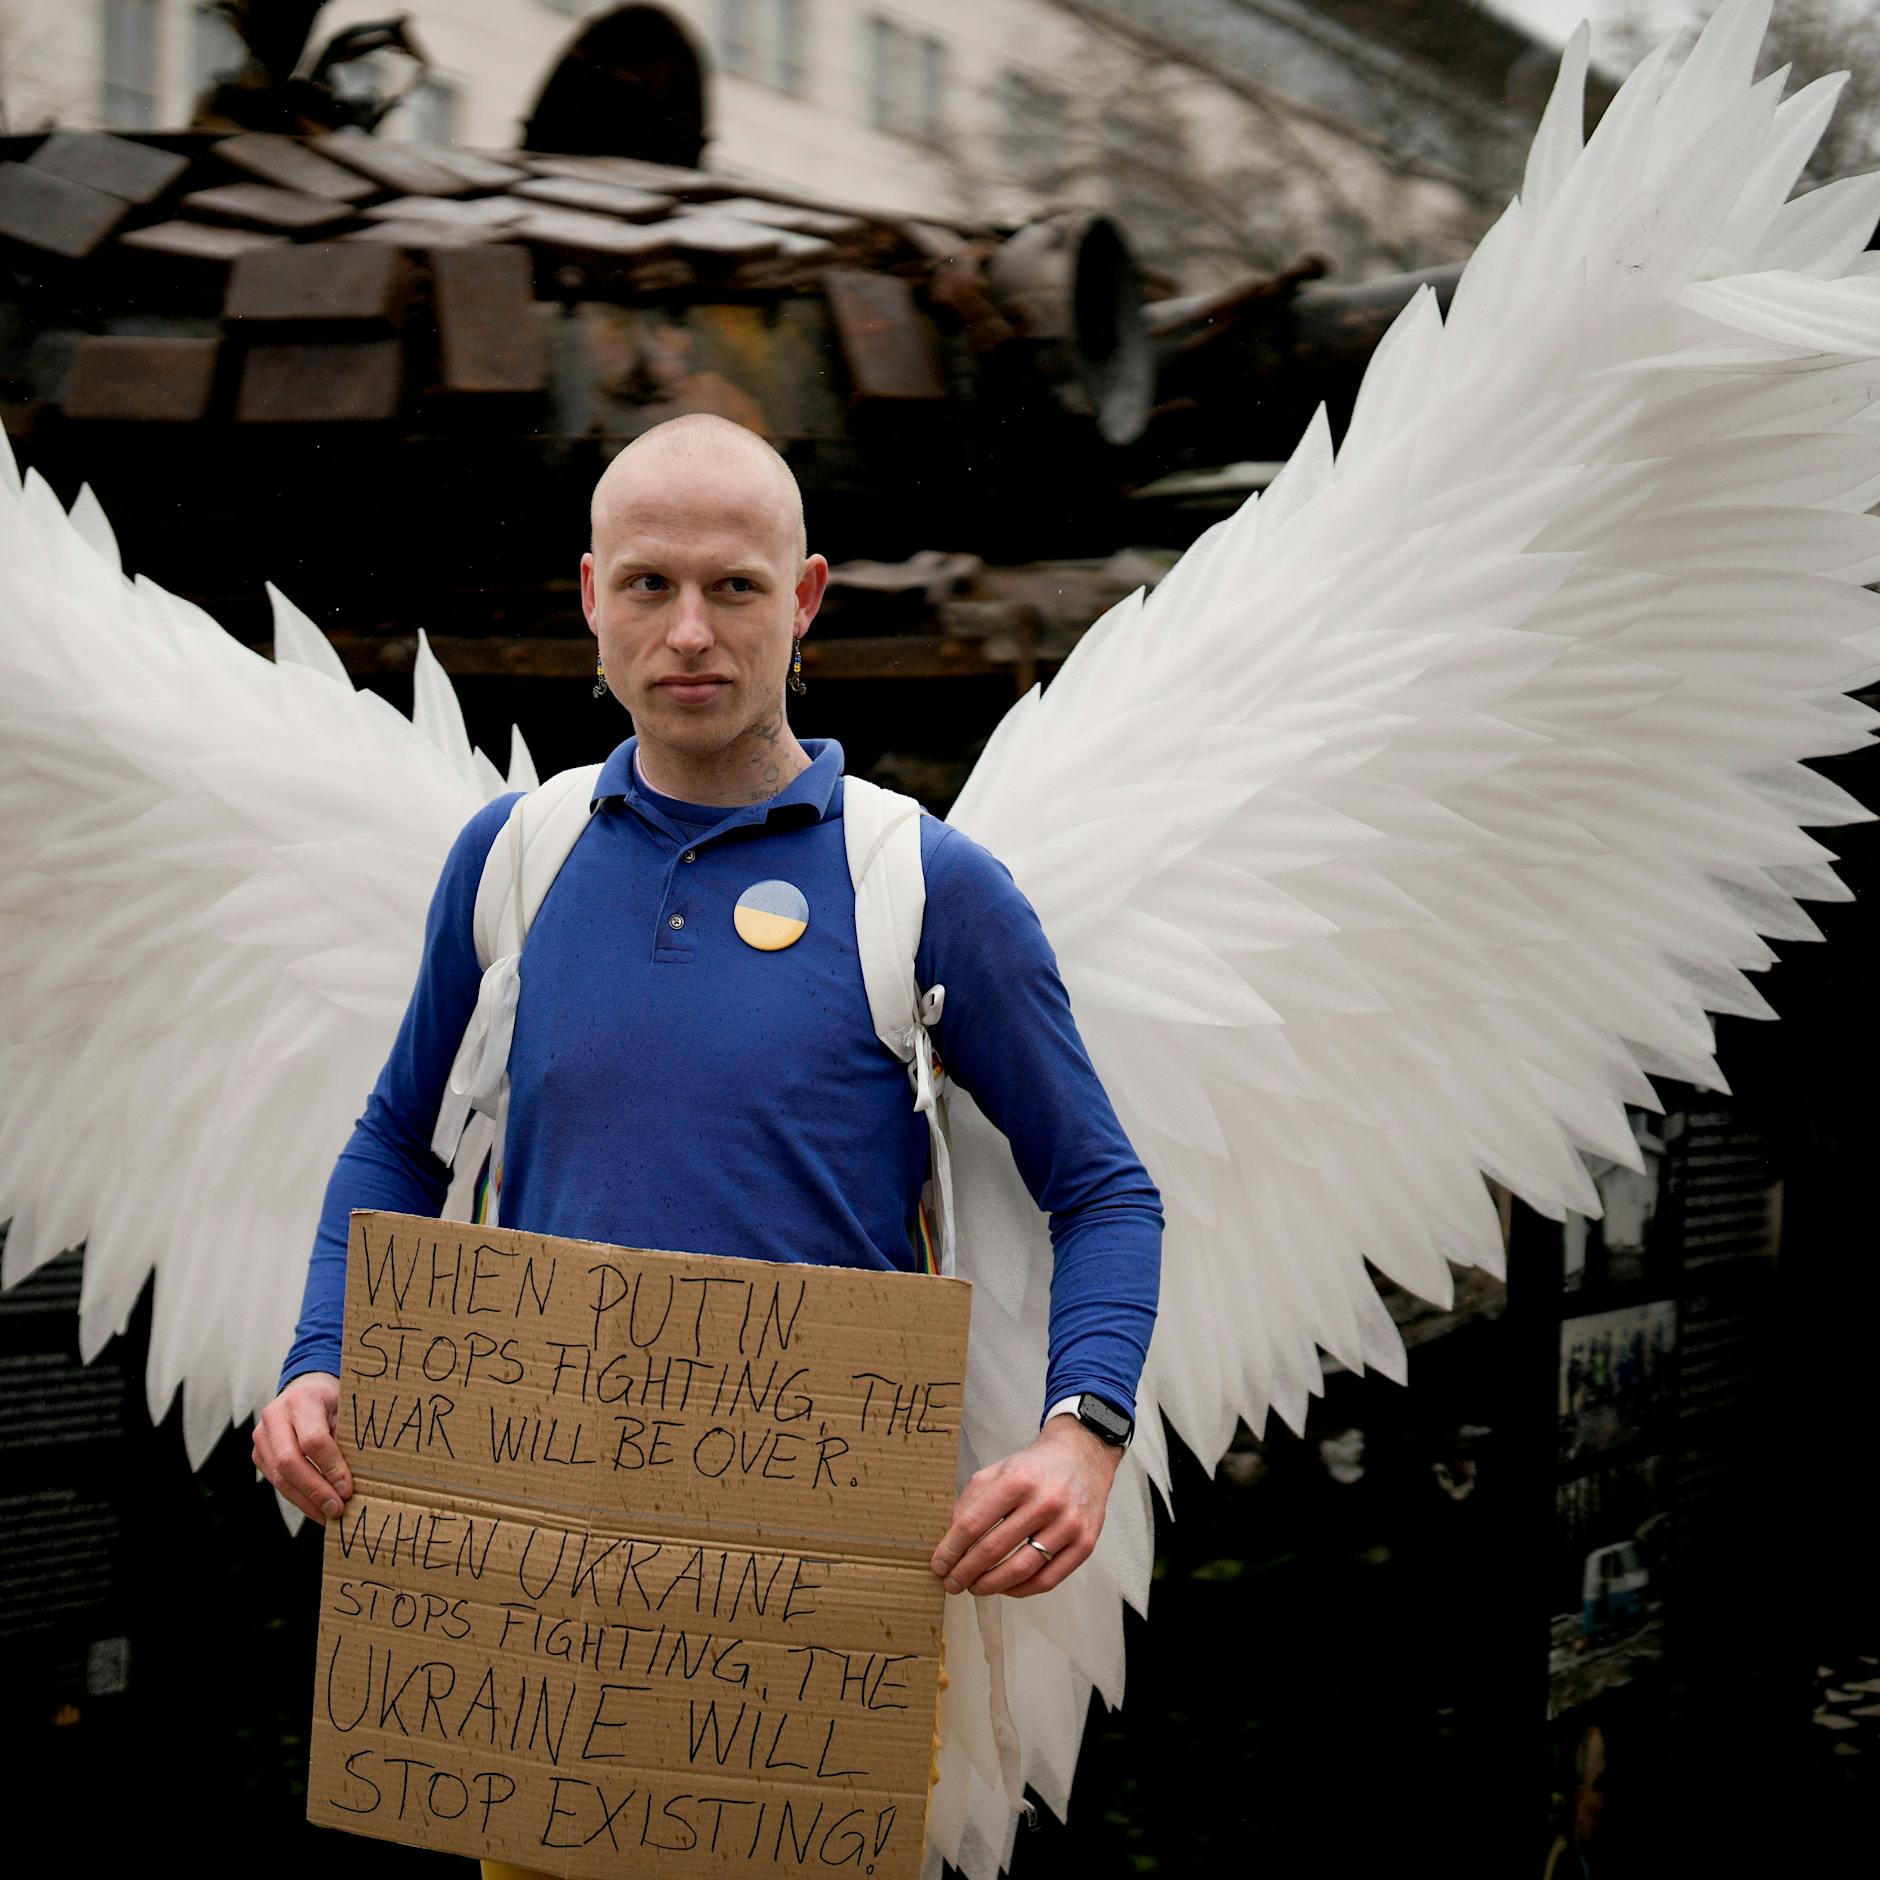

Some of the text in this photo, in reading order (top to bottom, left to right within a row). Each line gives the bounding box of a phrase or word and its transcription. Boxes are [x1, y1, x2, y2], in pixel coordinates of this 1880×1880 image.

[363, 1227, 805, 1358] WHEN PUTIN
[350, 1323, 961, 1435] STOPS FIGHTING, THE
[351, 1393, 858, 1489] WAR WILL BE OVER.
[338, 1505, 842, 1622] WHEN UKRAINE
[327, 1635, 869, 1778] UKRAINE WILL
[334, 1582, 918, 1710] STOPS FIGHTING, THE
[330, 1750, 897, 1875] STOP EXISTING!
